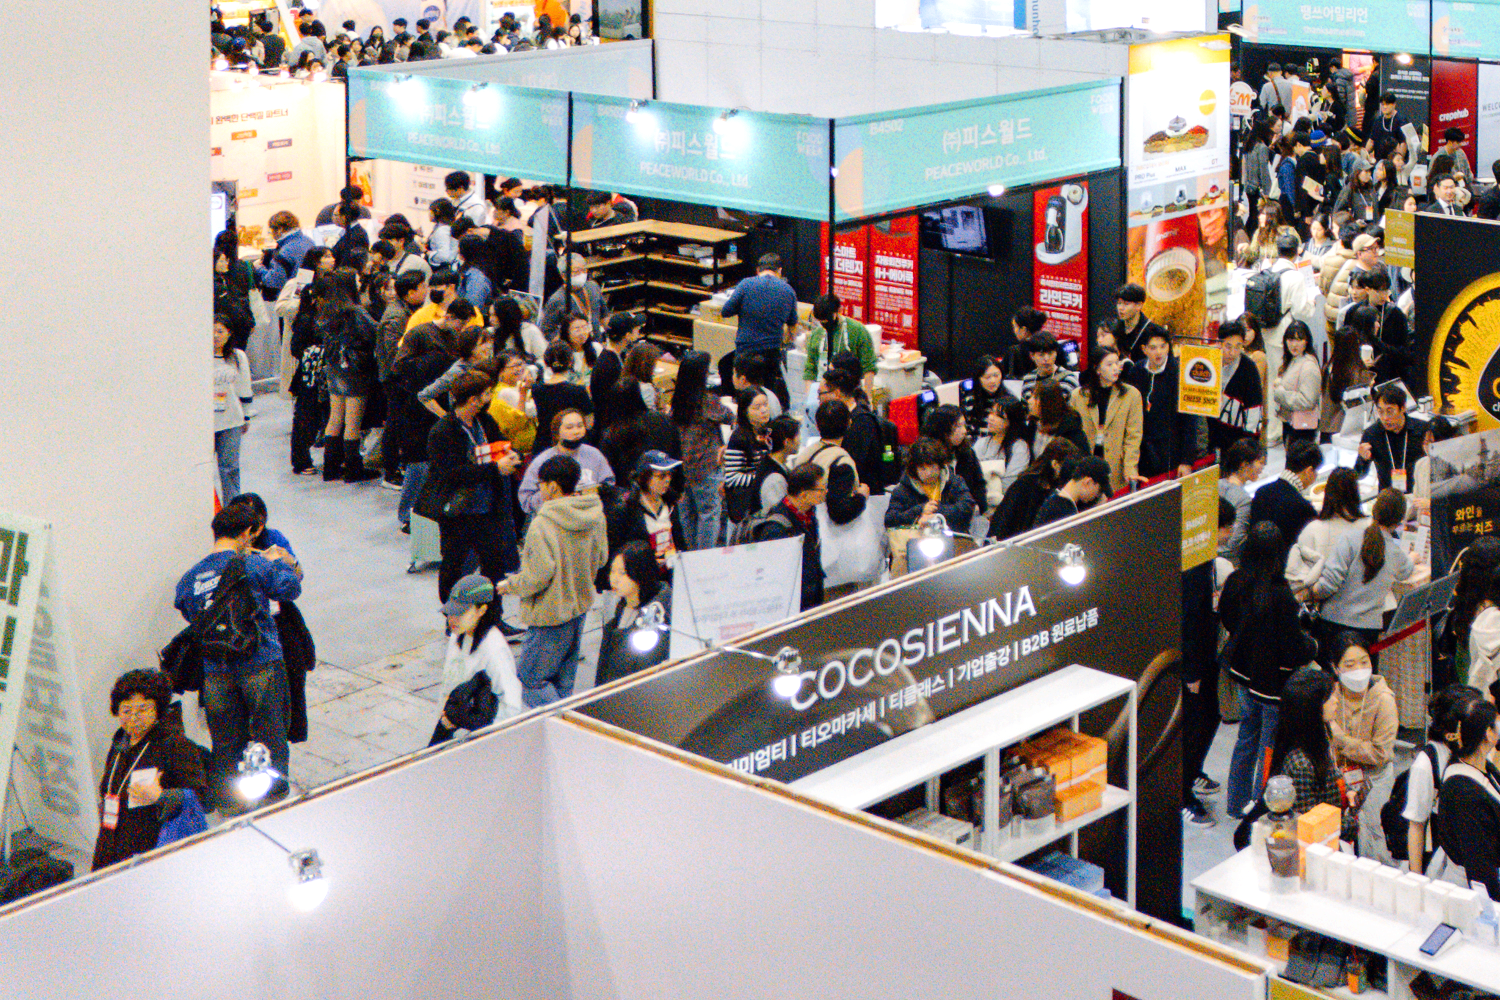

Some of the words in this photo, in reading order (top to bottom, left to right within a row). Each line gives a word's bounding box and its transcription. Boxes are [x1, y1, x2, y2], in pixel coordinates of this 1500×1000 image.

[1438, 107, 1470, 122] crepehub
[640, 161, 708, 184] PEACEWORLD
[925, 155, 1004, 181] PEACEWORLD
[1474, 520, 1494, 535] 치즈
[790, 584, 1037, 711] COCOSIENNA
[800, 701, 876, 749] 티오마카세
[888, 674, 946, 711] 티클래스
[957, 645, 1011, 683] 기업출강
[1021, 629, 1050, 656] B2B
[1050, 607, 1100, 644] 원료납품
